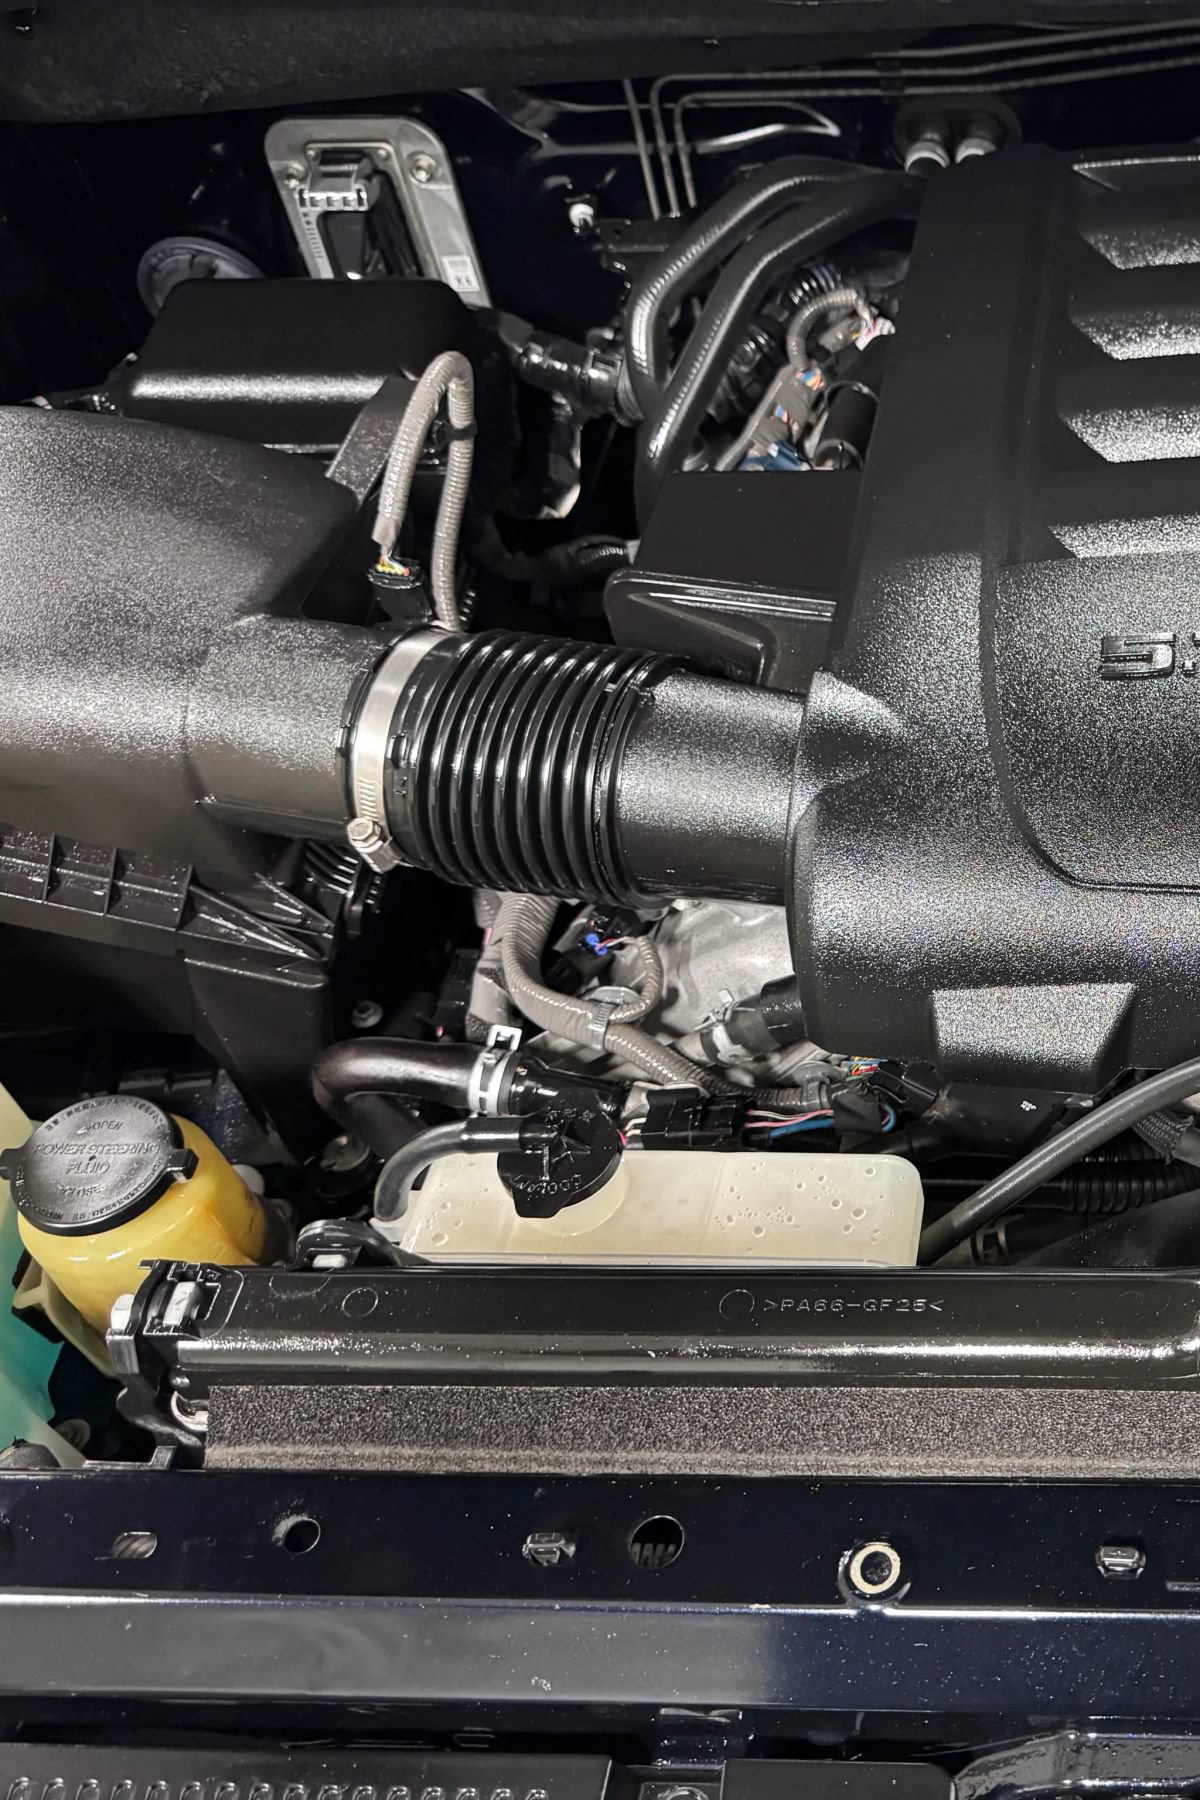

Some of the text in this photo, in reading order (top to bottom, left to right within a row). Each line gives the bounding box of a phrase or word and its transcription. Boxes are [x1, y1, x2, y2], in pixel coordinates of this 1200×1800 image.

[92, 1120, 123, 1131] OPEN
[34, 1142, 160, 1156] POWER STEERING
[66, 1161, 110, 1174] FLUID
